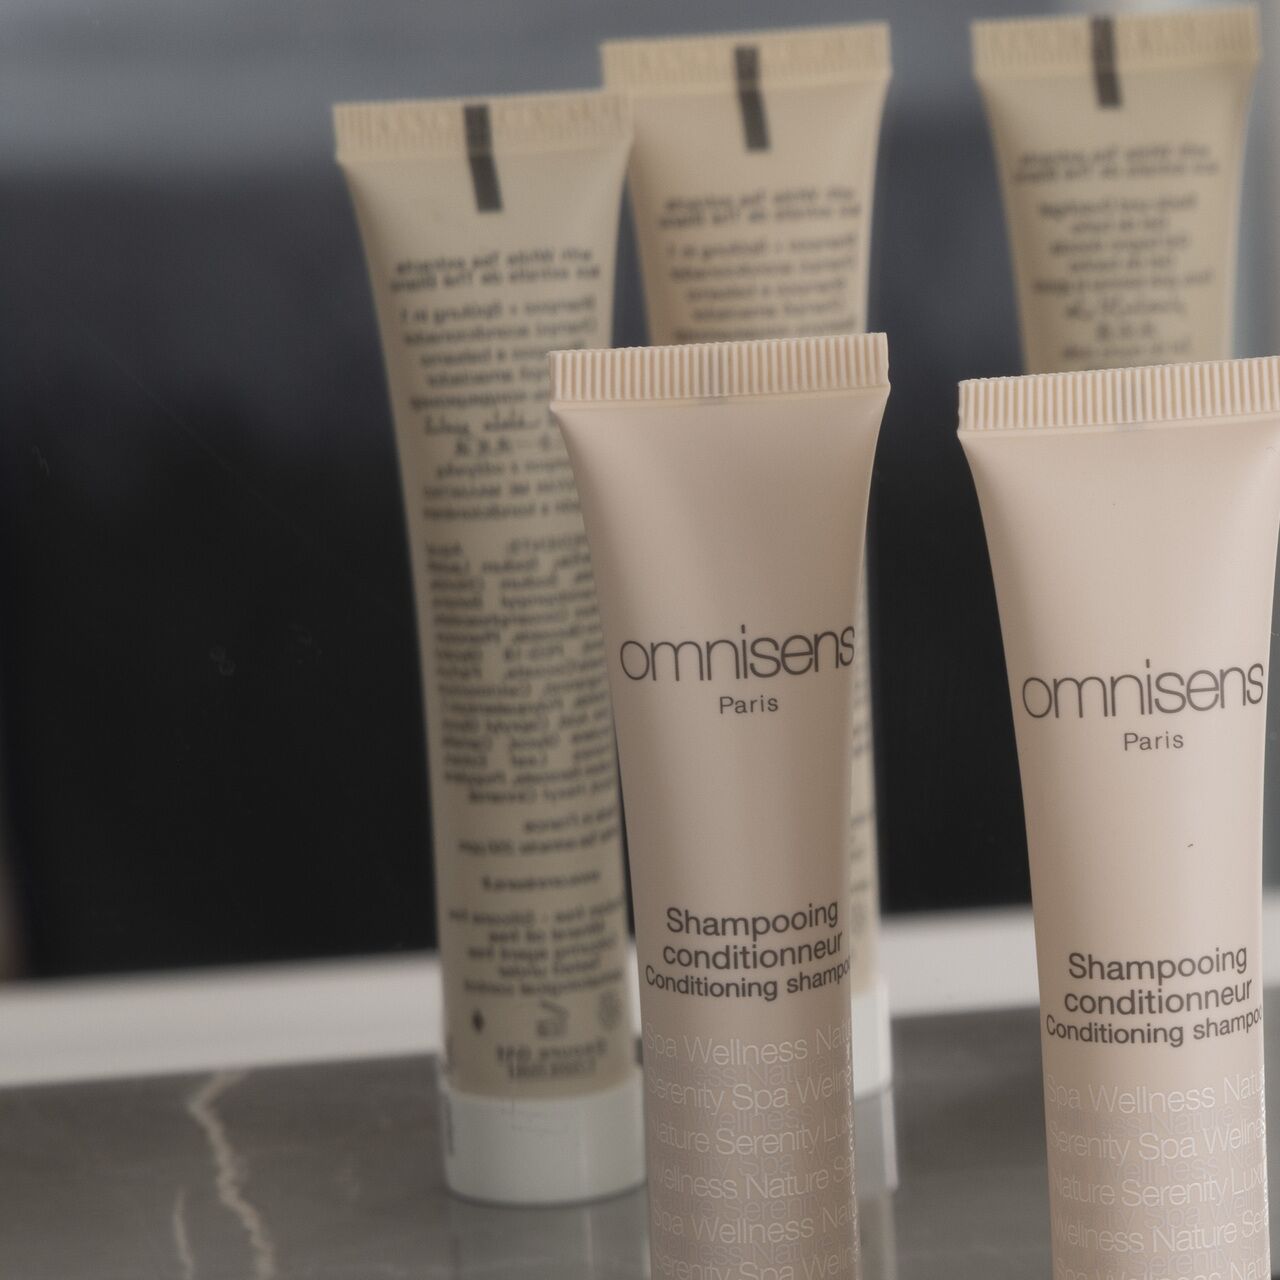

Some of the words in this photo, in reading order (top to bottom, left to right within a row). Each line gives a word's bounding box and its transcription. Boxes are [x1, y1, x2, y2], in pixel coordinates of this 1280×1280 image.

[619, 624, 856, 682] omnisens
[719, 694, 779, 715] Paris
[1022, 658, 1264, 718] omnisens
[1123, 731, 1184, 751] Paris
[666, 901, 838, 942] Shampooing
[663, 931, 843, 970] conditionneur
[1068, 946, 1248, 986] Shampooing
[645, 964, 778, 1002] Conditioning
[787, 954, 850, 994] shampo
[1064, 979, 1253, 1015] conditionneur
[1046, 1014, 1184, 1048] Conditioning
[683, 1036, 808, 1066] Wellness
[732, 1083, 790, 1116] Spa
[1088, 1084, 1216, 1114] Wellness
[715, 1124, 821, 1155] Serenity
[1139, 1132, 1198, 1166] Spa
[746, 1167, 830, 1199] Nature
[1121, 1176, 1229, 1207] Serenity
[691, 1216, 815, 1244] Wellness
[1153, 1220, 1237, 1253] Nature
